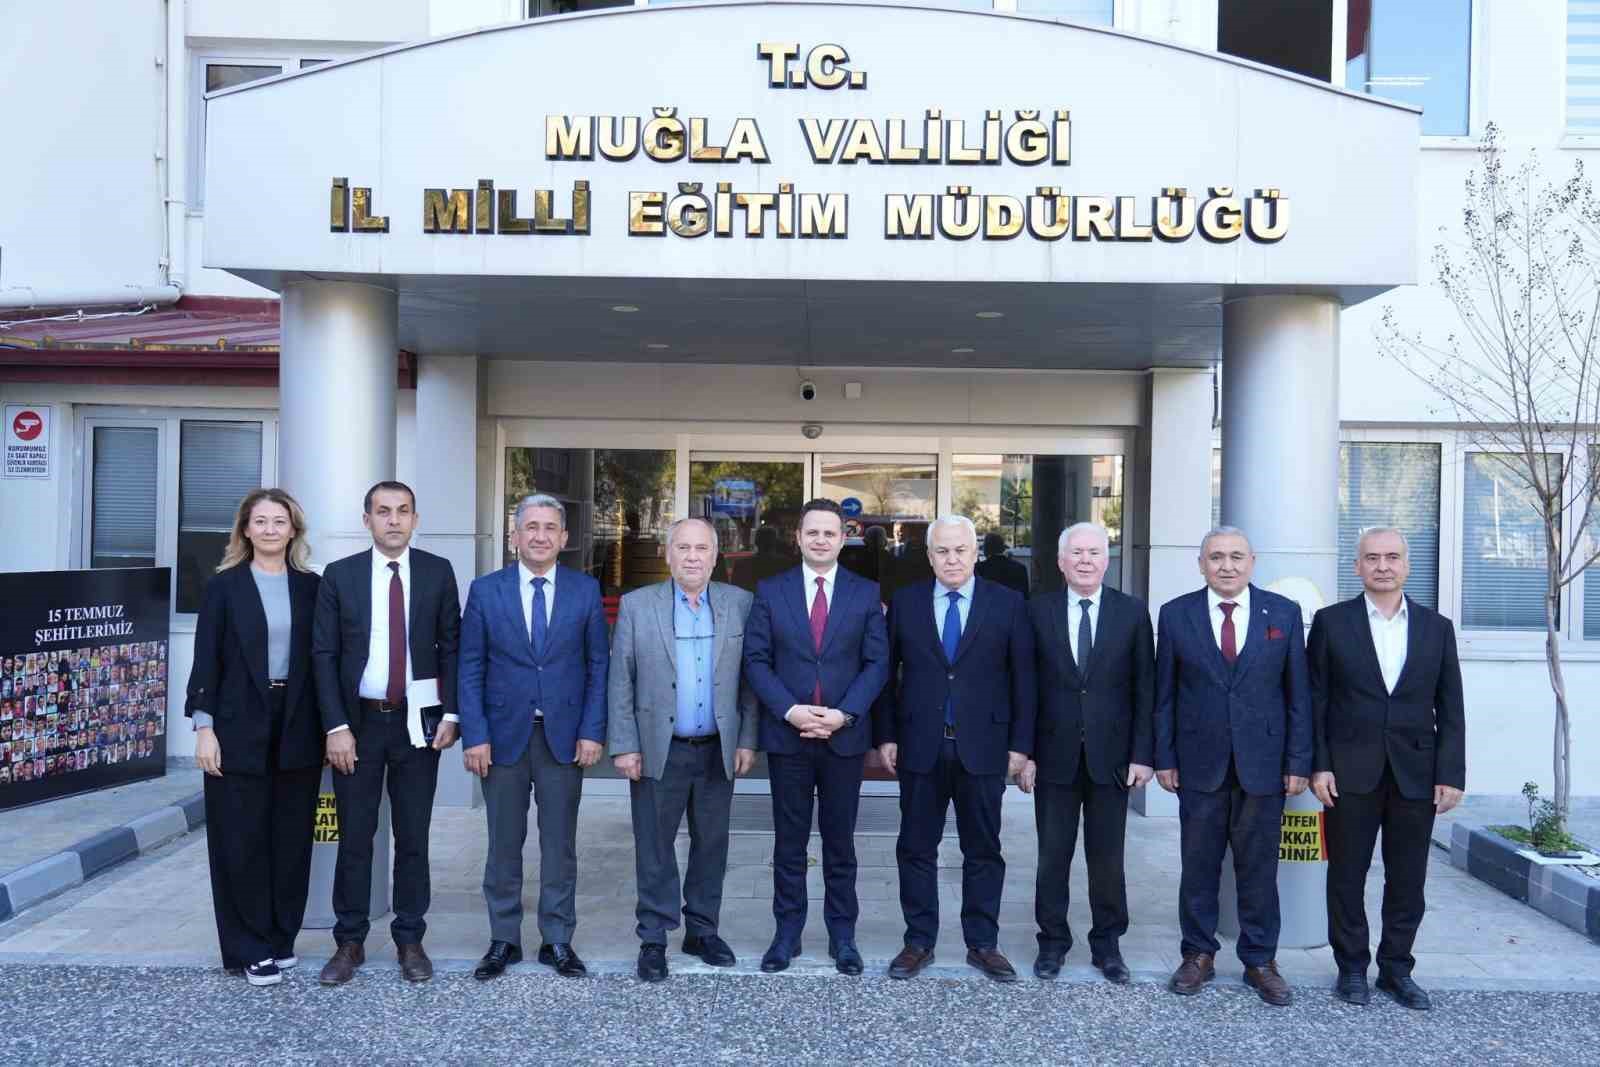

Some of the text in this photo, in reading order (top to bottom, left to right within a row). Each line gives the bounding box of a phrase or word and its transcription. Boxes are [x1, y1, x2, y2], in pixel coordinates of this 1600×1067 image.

[757, 43, 867, 90] T.C.
[545, 106, 1072, 167] MUĞLA VALİLİĞİ
[330, 177, 1290, 244] İL MİLLİ EĞİTİM MÜDÜRLÜĞÜ
[48, 604, 125, 623] 15 TEMMUZ
[34, 619, 134, 646] ŞEHİTLERİMİZ
[1278, 846, 1320, 861] DİNİZ
